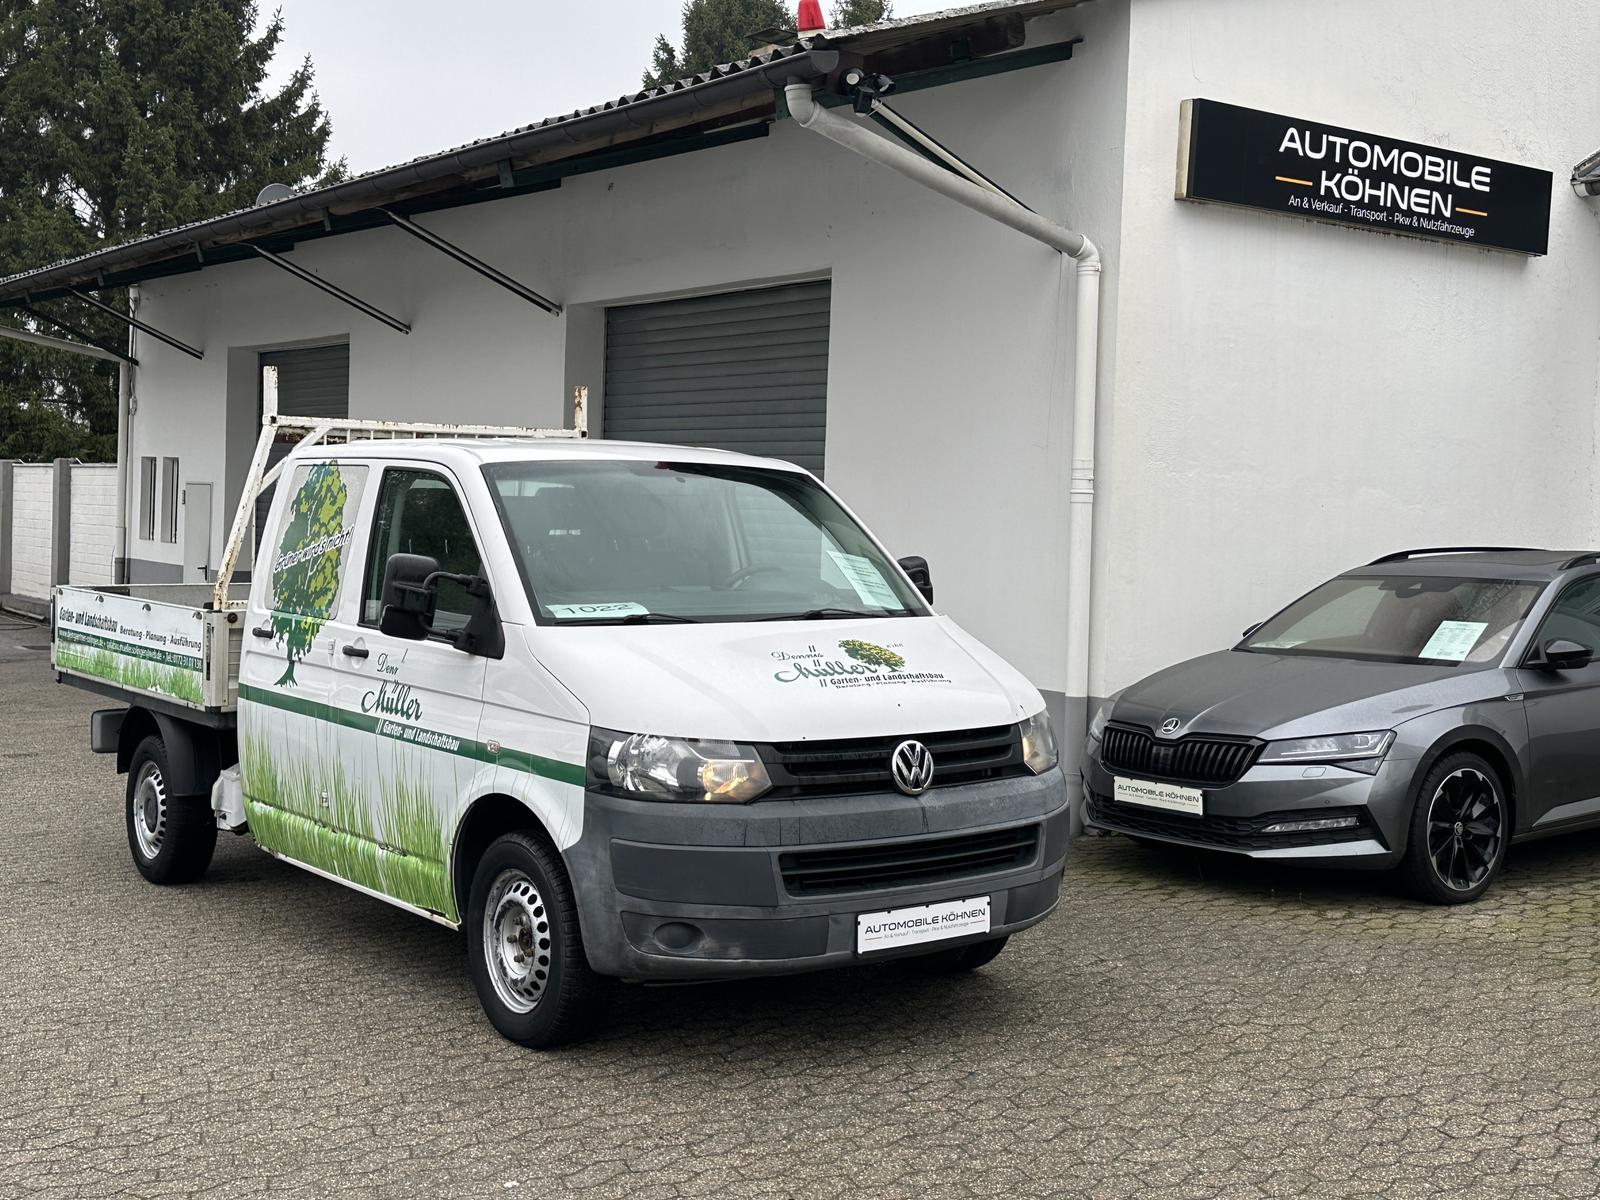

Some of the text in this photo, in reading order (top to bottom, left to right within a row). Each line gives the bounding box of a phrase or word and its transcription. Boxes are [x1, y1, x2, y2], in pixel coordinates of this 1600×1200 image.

[1279, 127, 1492, 192] AUTOMOBILE
[1320, 168, 1452, 218] KÖHNEN
[1288, 195, 1301, 206] An
[1303, 197, 1309, 208] &
[1310, 199, 1344, 213] Verkauf
[1350, 205, 1387, 222] Transport
[1394, 214, 1411, 226] Pkw
[1412, 216, 1418, 227] &
[1420, 218, 1475, 238] Nutzfahrzeuge
[562, 604, 633, 614] 1022
[120, 625, 142, 640] Beratung
[146, 630, 166, 645] Planung
[170, 635, 202, 652] Ausführung
[774, 660, 878, 683] Müller
[830, 672, 945, 686] Garten- und Landschaftsbau
[361, 680, 422, 721] Müller
[383, 721, 460, 751] Garten- und Landschaftsbau
[1117, 784, 1165, 798] AUTOMOBILE
[1165, 791, 1199, 803] KÖHNEN
[864, 907, 986, 935] AUTOMOBILE KÖHNEN
